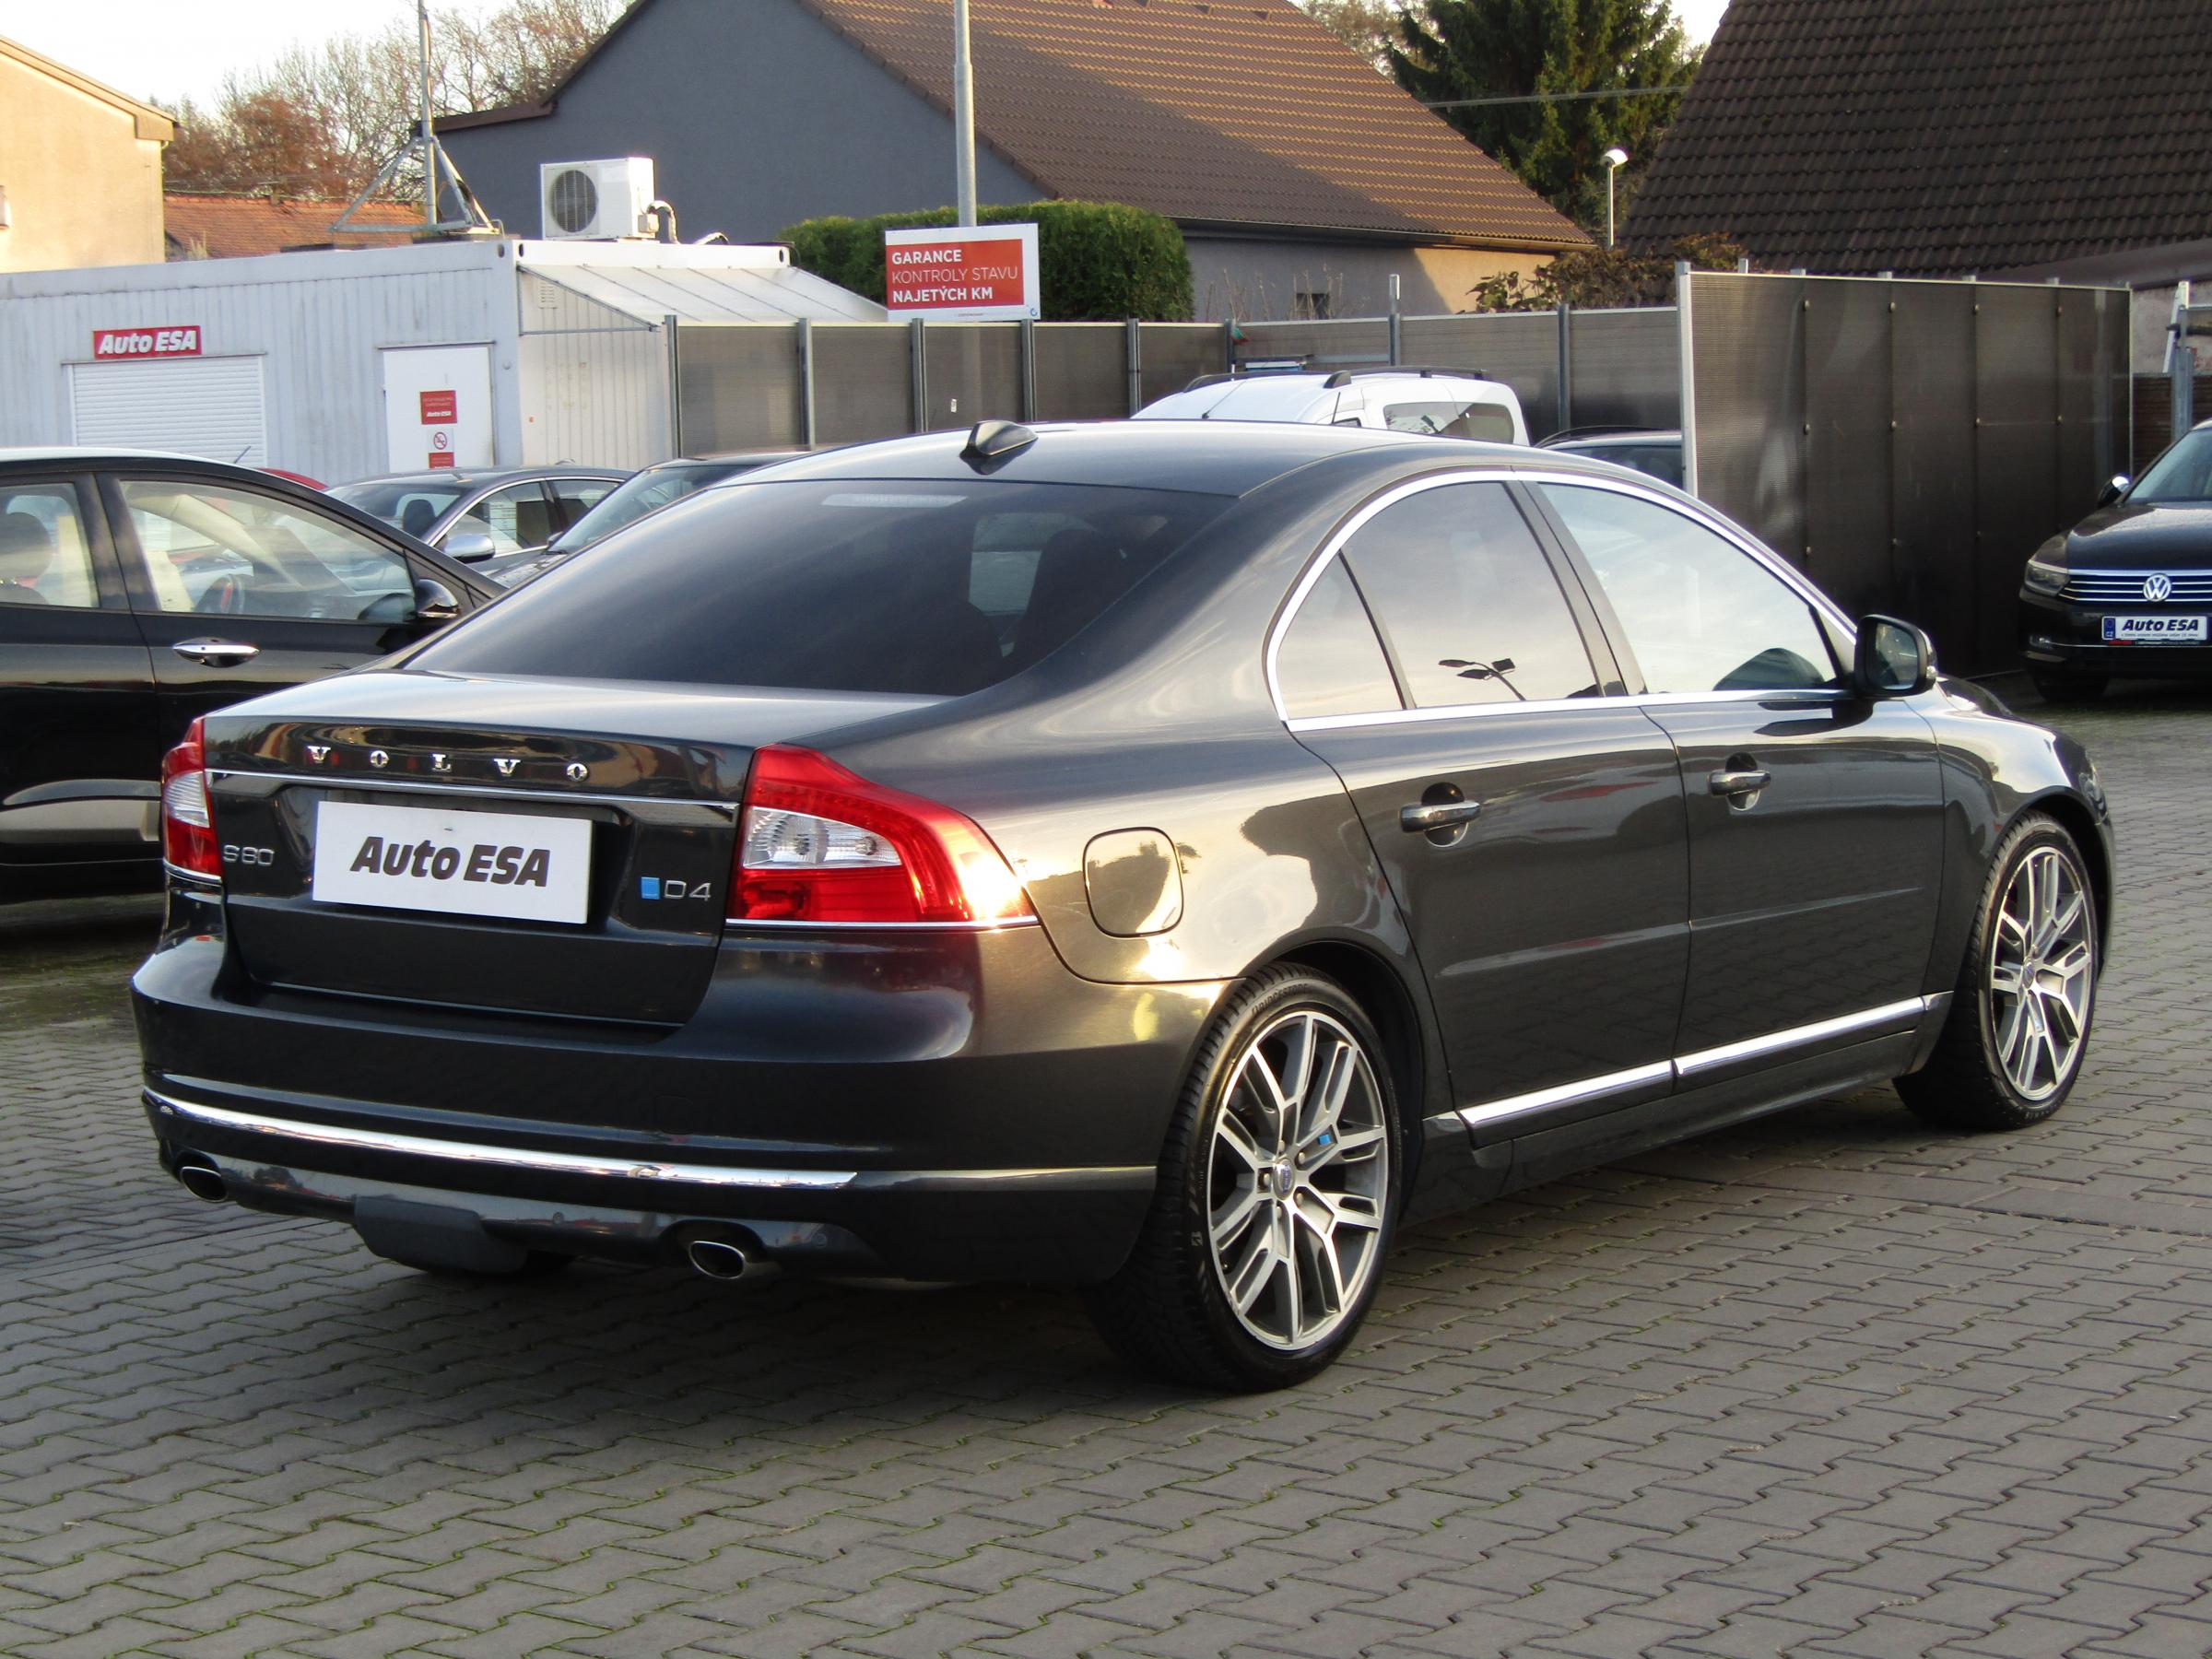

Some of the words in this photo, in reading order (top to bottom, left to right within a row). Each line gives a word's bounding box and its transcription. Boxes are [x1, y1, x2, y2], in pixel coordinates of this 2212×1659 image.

[892, 249, 962, 265] GARANCE
[892, 268, 968, 285] KONTROLY
[972, 265, 1018, 281] STAVU
[893, 286, 968, 303] NAJETÝCH
[971, 287, 994, 300] KM
[98, 333, 154, 355] Auto
[155, 330, 196, 352] ESA
[2122, 619, 2165, 631] Auto
[2167, 618, 2199, 631] ESA
[307, 745, 588, 782] VOLVO
[223, 844, 275, 866] S80
[349, 836, 460, 880] Auto
[463, 843, 550, 887] ESA
[665, 879, 712, 901] D4
